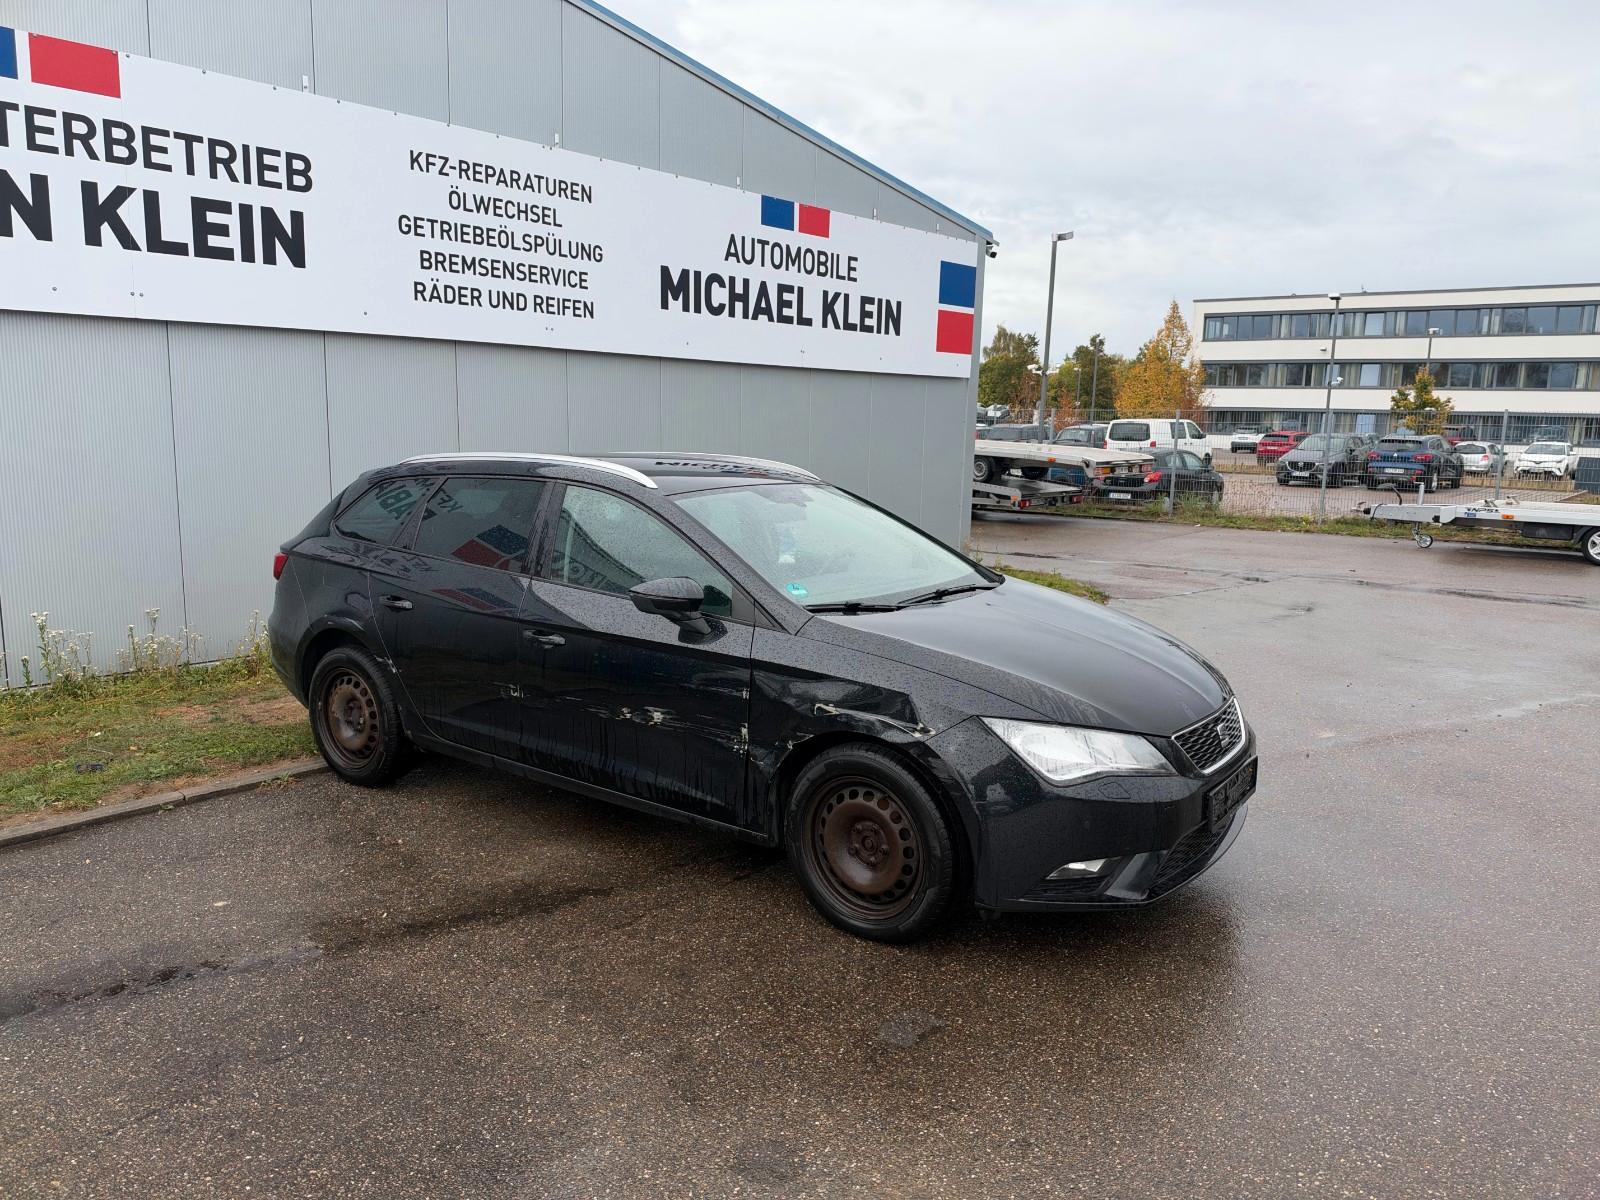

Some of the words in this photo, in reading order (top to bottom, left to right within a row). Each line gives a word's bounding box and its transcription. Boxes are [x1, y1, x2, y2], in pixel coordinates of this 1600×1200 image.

[409, 150, 592, 203] KFZ-REPARATUREN
[80, 180, 306, 269] KLEIN
[448, 185, 563, 227] ÖLWECHSEL
[398, 214, 604, 263] GETRIEBEÖLSPÜLUNG
[724, 233, 859, 282] AUTOMOBILE
[419, 249, 589, 290] BREMSENSERVICE
[413, 278, 483, 308] RÄDER
[488, 289, 528, 312] UND
[533, 294, 594, 319] REIFEN
[660, 265, 813, 327] MICHAEL
[821, 289, 902, 336] KLEIN
